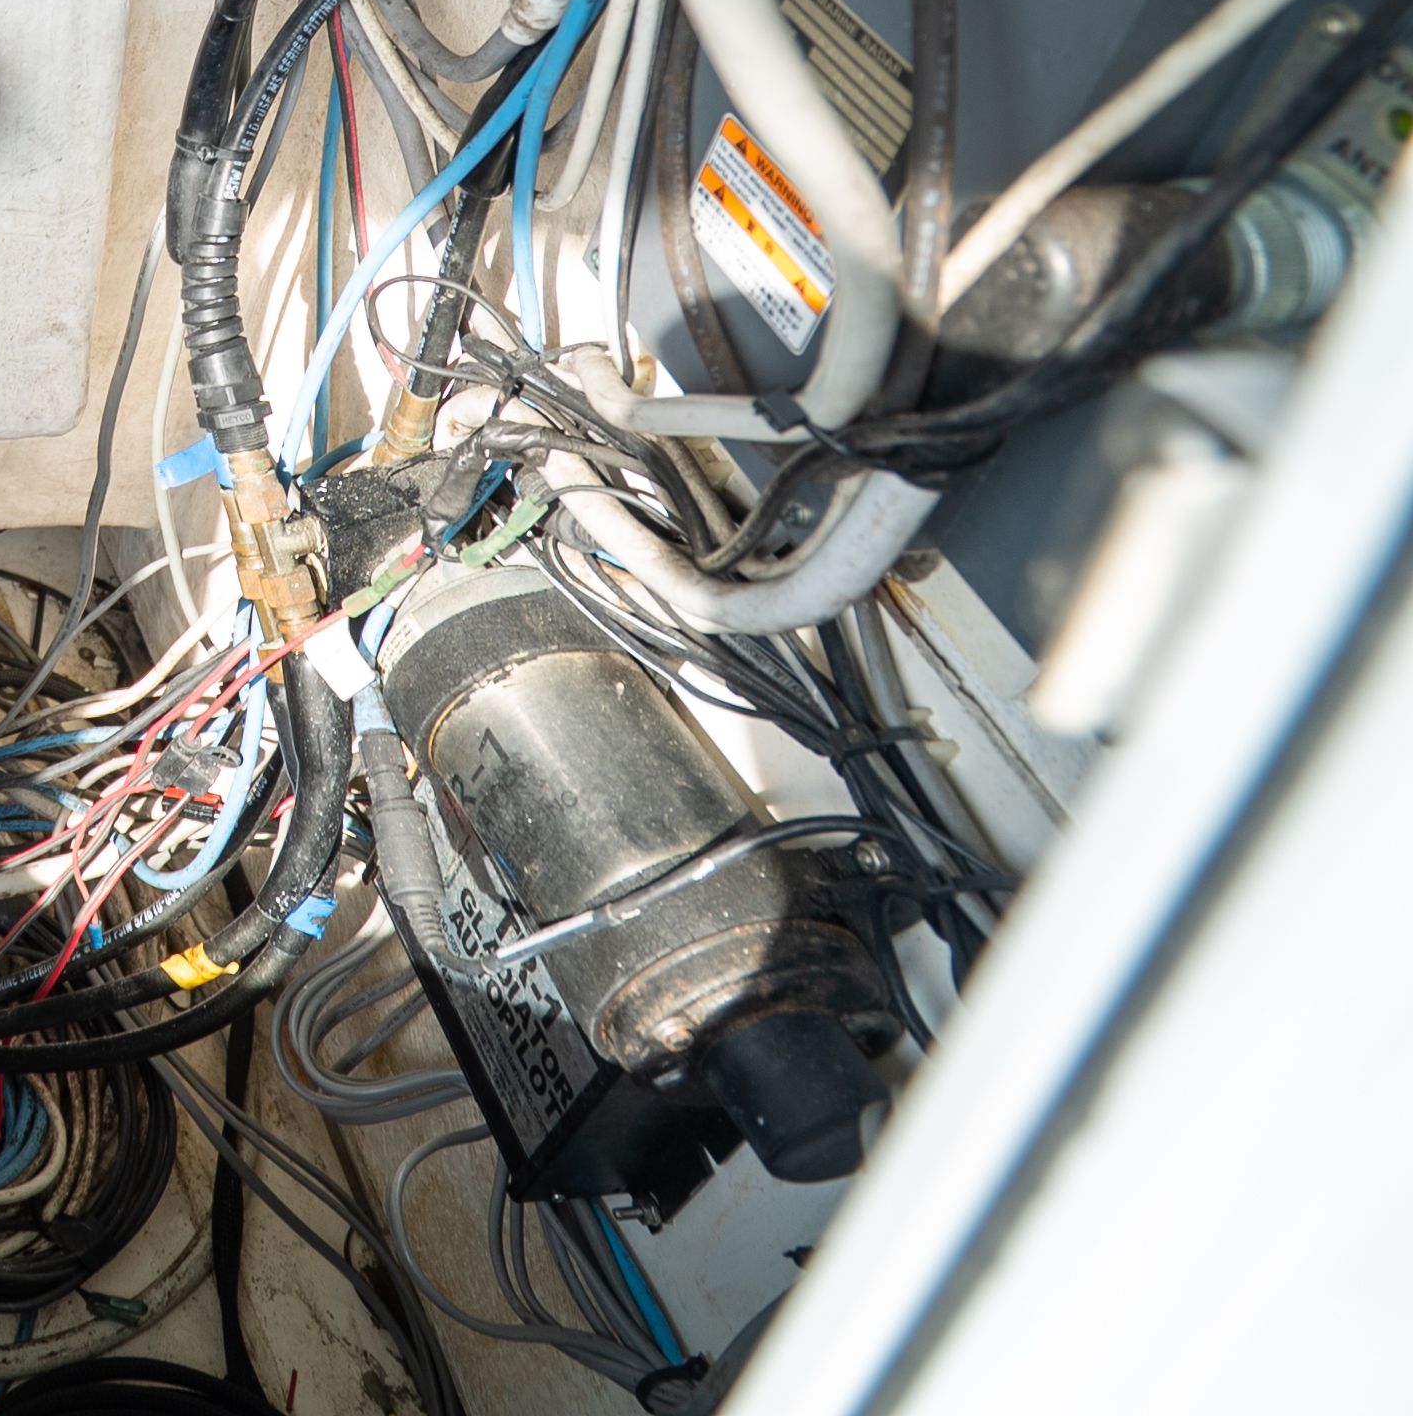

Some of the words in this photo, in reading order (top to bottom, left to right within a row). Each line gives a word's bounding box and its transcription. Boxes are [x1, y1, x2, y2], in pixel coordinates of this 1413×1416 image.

[277, 34, 309, 75] SERIES
[859, 34, 903, 78] RADAR
[715, 149, 741, 179] remove
[728, 151, 751, 176] avoid
[750, 175, 786, 215] electrical
[755, 155, 817, 225] WARNING
[221, 415, 252, 424] HEYCO
[20, 964, 52, 984] STEERIN
